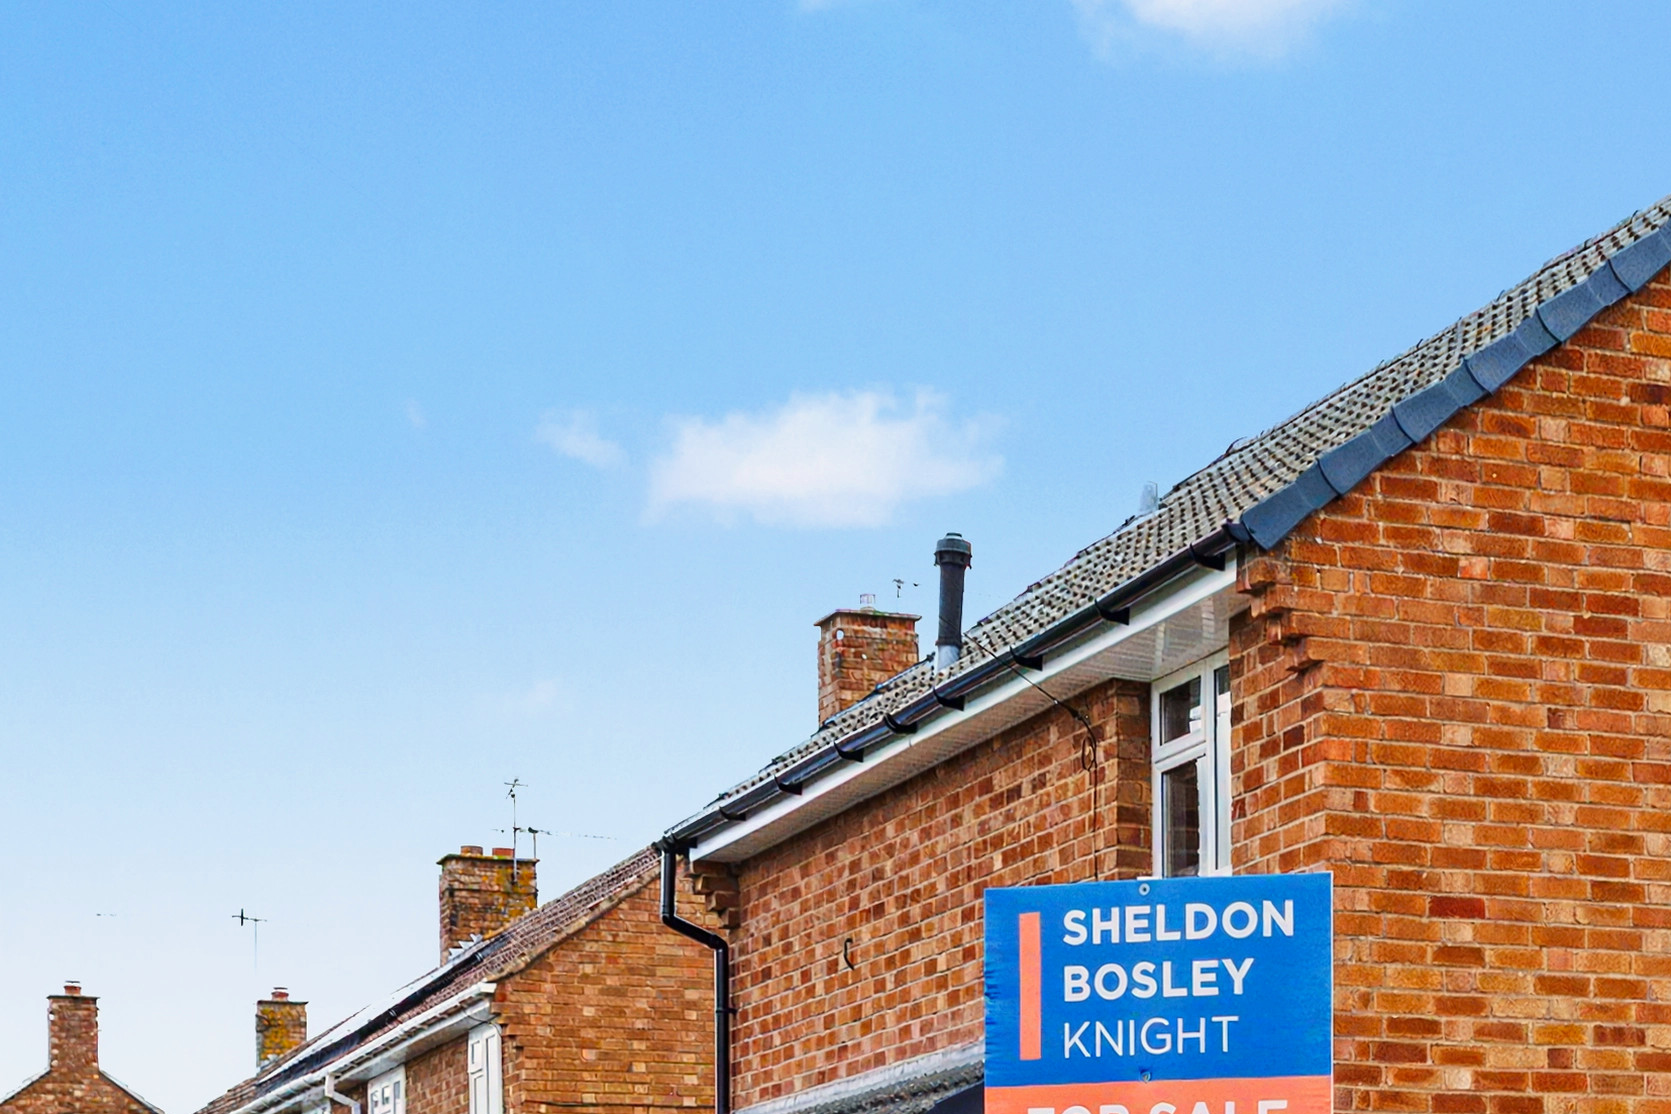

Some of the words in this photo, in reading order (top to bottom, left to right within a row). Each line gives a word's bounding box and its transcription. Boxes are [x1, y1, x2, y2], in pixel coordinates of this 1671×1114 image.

[1062, 899, 1295, 946] SHELDON
[1063, 957, 1255, 1003] BOSLEY
[1063, 1015, 1239, 1059] KNIGHT
